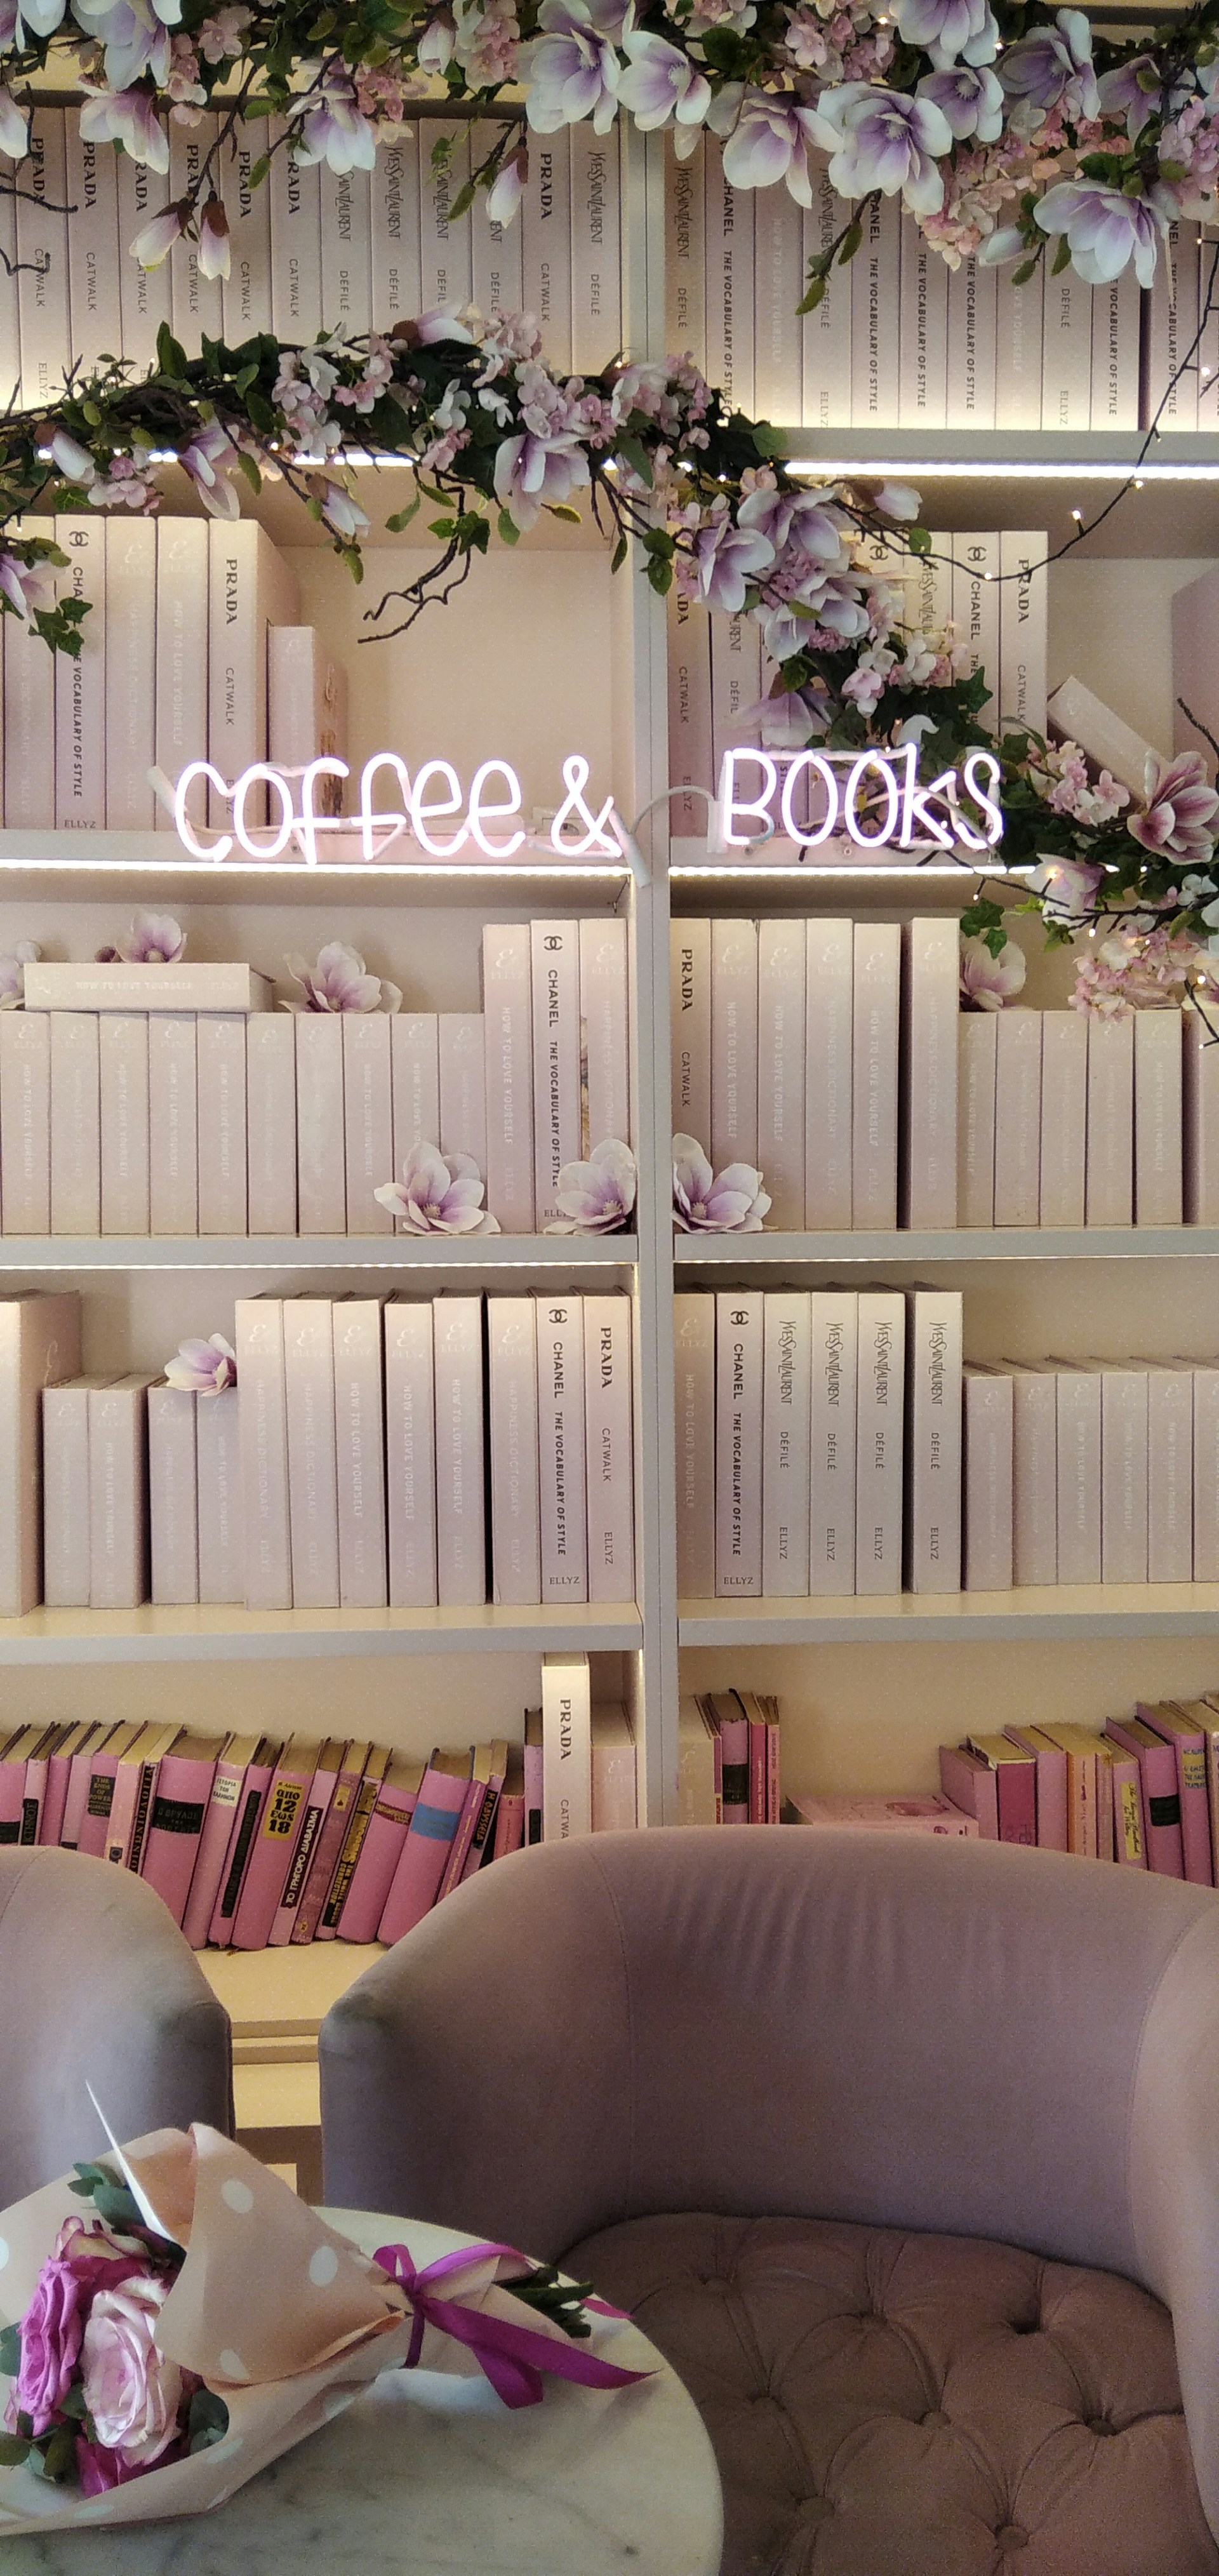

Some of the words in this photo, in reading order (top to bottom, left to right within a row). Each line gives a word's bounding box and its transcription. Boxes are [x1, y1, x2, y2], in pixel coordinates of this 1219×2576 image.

[83, 142, 97, 208] PRADA
[135, 162, 147, 211] RADA
[239, 152, 251, 218] PRADA
[288, 162, 300, 215] RADA
[540, 153, 552, 220] PRADA
[723, 181, 734, 236] HANEL
[869, 199, 880, 243] ANEL
[35, 248, 45, 307] CATWALK
[724, 251, 732, 270] THE
[869, 258, 878, 278] THE
[918, 253, 926, 274] THE
[967, 257, 975, 276] THE
[86, 252, 97, 310] CATWALK
[190, 254, 199, 313] CATWALK
[241, 262, 251, 320] CATWALK
[290, 258, 299, 317] CATWALK
[437, 270, 446, 302] DÉFIL
[541, 264, 550, 321] CATWALK
[724, 276, 732, 347] VOCABULARY
[869, 282, 878, 354] VOCABULARY
[918, 278, 927, 350] VOCABULARY
[967, 279, 975, 352] VOCABULARY
[1110, 288, 1118, 360] VOCABULARY
[724, 351, 732, 369] OF
[869, 357, 878, 374] OF
[918, 354, 926, 373] OF
[967, 357, 975, 374] OF
[1110, 363, 1118, 379] OF
[38, 363, 48, 398] ELLYZ
[724, 373, 732, 406] STYLE
[869, 378, 878, 411] STYLE
[917, 374, 926, 408] STYLE
[967, 378, 975, 410] STYLE
[1060, 390, 1068, 425] ELLYZ
[1110, 382, 1118, 415] STYLE
[1169, 382, 1177, 415] STYLE
[73, 567, 84, 599] CHA
[226, 559, 238, 625] PRADA
[1018, 559, 1029, 623] PRADA
[676, 592, 689, 624] ADA
[971, 582, 981, 639] CHANEL
[74, 667, 83, 740] VOCABULARY
[225, 667, 235, 725] CATWALK
[679, 667, 689, 724] CATWALK
[729, 681, 738, 714] DÉFIL
[74, 744, 83, 759] OF
[74, 763, 83, 797] STYLE
[551, 754, 623, 858] &
[681, 949, 693, 1011] PRADA
[548, 970, 559, 1027] CHANEL
[549, 1041, 558, 1061] THE
[549, 1064, 560, 1128] VOCABULARY
[681, 1051, 691, 1107] CATWALK
[550, 1131, 560, 1149] OF
[550, 1155, 560, 1187] STYLE
[543, 1210, 569, 1218] ELL
[553, 1342, 565, 1398] CHANEL
[601, 1327, 613, 1389] PRADA
[733, 1344, 744, 1400] CHANEL
[554, 1411, 564, 1432] THE
[731, 1412, 742, 1434] THE
[554, 1434, 566, 1504] VOCABULARY
[602, 1427, 612, 1482] CATWALK
[731, 1436, 742, 1504] VOCABULARY
[556, 1506, 566, 1522] OF
[731, 1507, 742, 1522] OF
[557, 1524, 566, 1556] STYLE
[604, 1531, 614, 1565] ELLYZ
[731, 1525, 742, 1556] STYLE
[779, 1527, 790, 1559] ELLYZ
[827, 1528, 837, 1561] ELLYZ
[874, 1528, 884, 1560] ELLYZ
[929, 1528, 940, 1560] ELLYZ
[549, 1576, 580, 1585] ELLYZ
[723, 1576, 754, 1585] ELLYZ
[560, 1699, 572, 1760] PRADA
[130, 1768, 153, 1869] ΟΙΝΩΝΙΟΛΟΓΙΑ
[274, 1799, 296, 1812] 12
[561, 1799, 570, 1839] CATWA
[269, 1819, 291, 1834] 18
[301, 1810, 319, 1853] ΔΙΑΒΑΣΜΑ
[290, 1854, 306, 1890] ΓΡΗΓΟΡΟ
[286, 1892, 295, 1904] ΤΟ
